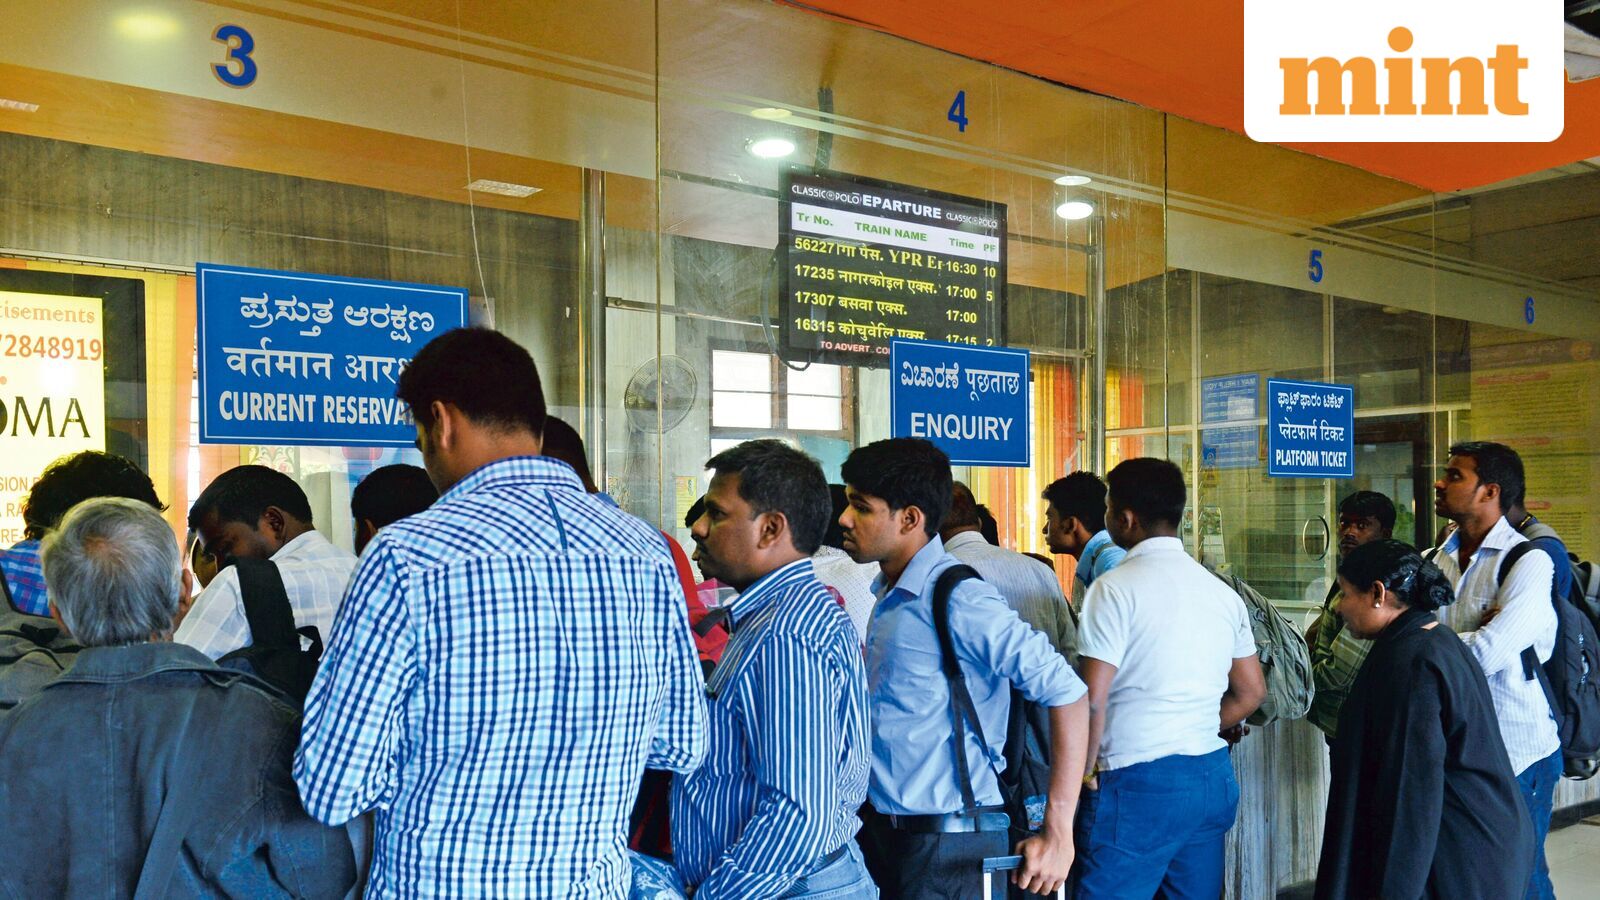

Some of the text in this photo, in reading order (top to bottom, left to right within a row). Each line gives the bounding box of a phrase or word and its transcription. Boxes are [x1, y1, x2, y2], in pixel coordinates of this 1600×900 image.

[213, 24, 257, 87] 3
[947, 91, 969, 133] 4
[792, 184, 826, 199] CLASSIC
[861, 195, 942, 220] EPARTURE
[796, 212, 997, 252] Tr No. TRAIN NAME Time PF
[795, 236, 835, 255] 56227
[889, 249, 923, 267] YPR
[946, 260, 977, 275] 16:30
[983, 265, 997, 279] 10
[1309, 250, 1323, 283] 5
[794, 263, 835, 281] 17235
[838, 270, 904, 291] नागरकोइल
[946, 285, 977, 300] 17:00
[986, 290, 993, 302] 5
[0, 300, 95, 324] isements
[240, 292, 435, 344] ಪ್ರಸ್ತುತ ಆರಕ್ಷಣ
[794, 291, 977, 324] 17307 बसवा एक्स. 17:00
[1525, 297, 1534, 324] 6
[0, 333, 102, 361] 2848919
[794, 317, 835, 334] 16315
[946, 333, 977, 346] 17:15
[820, 341, 833, 349] TO
[222, 337, 334, 380] वर्तमान
[901, 360, 1020, 402] ವಿಚಾರಣೆ पूछताछ
[0, 395, 91, 438] MA
[219, 391, 316, 423] CURRENT
[911, 412, 1014, 441] ENQUIRY
[1278, 417, 1345, 442] प्लेटफार्म टिकट
[1275, 449, 1347, 468] PLATFORM TICKET
